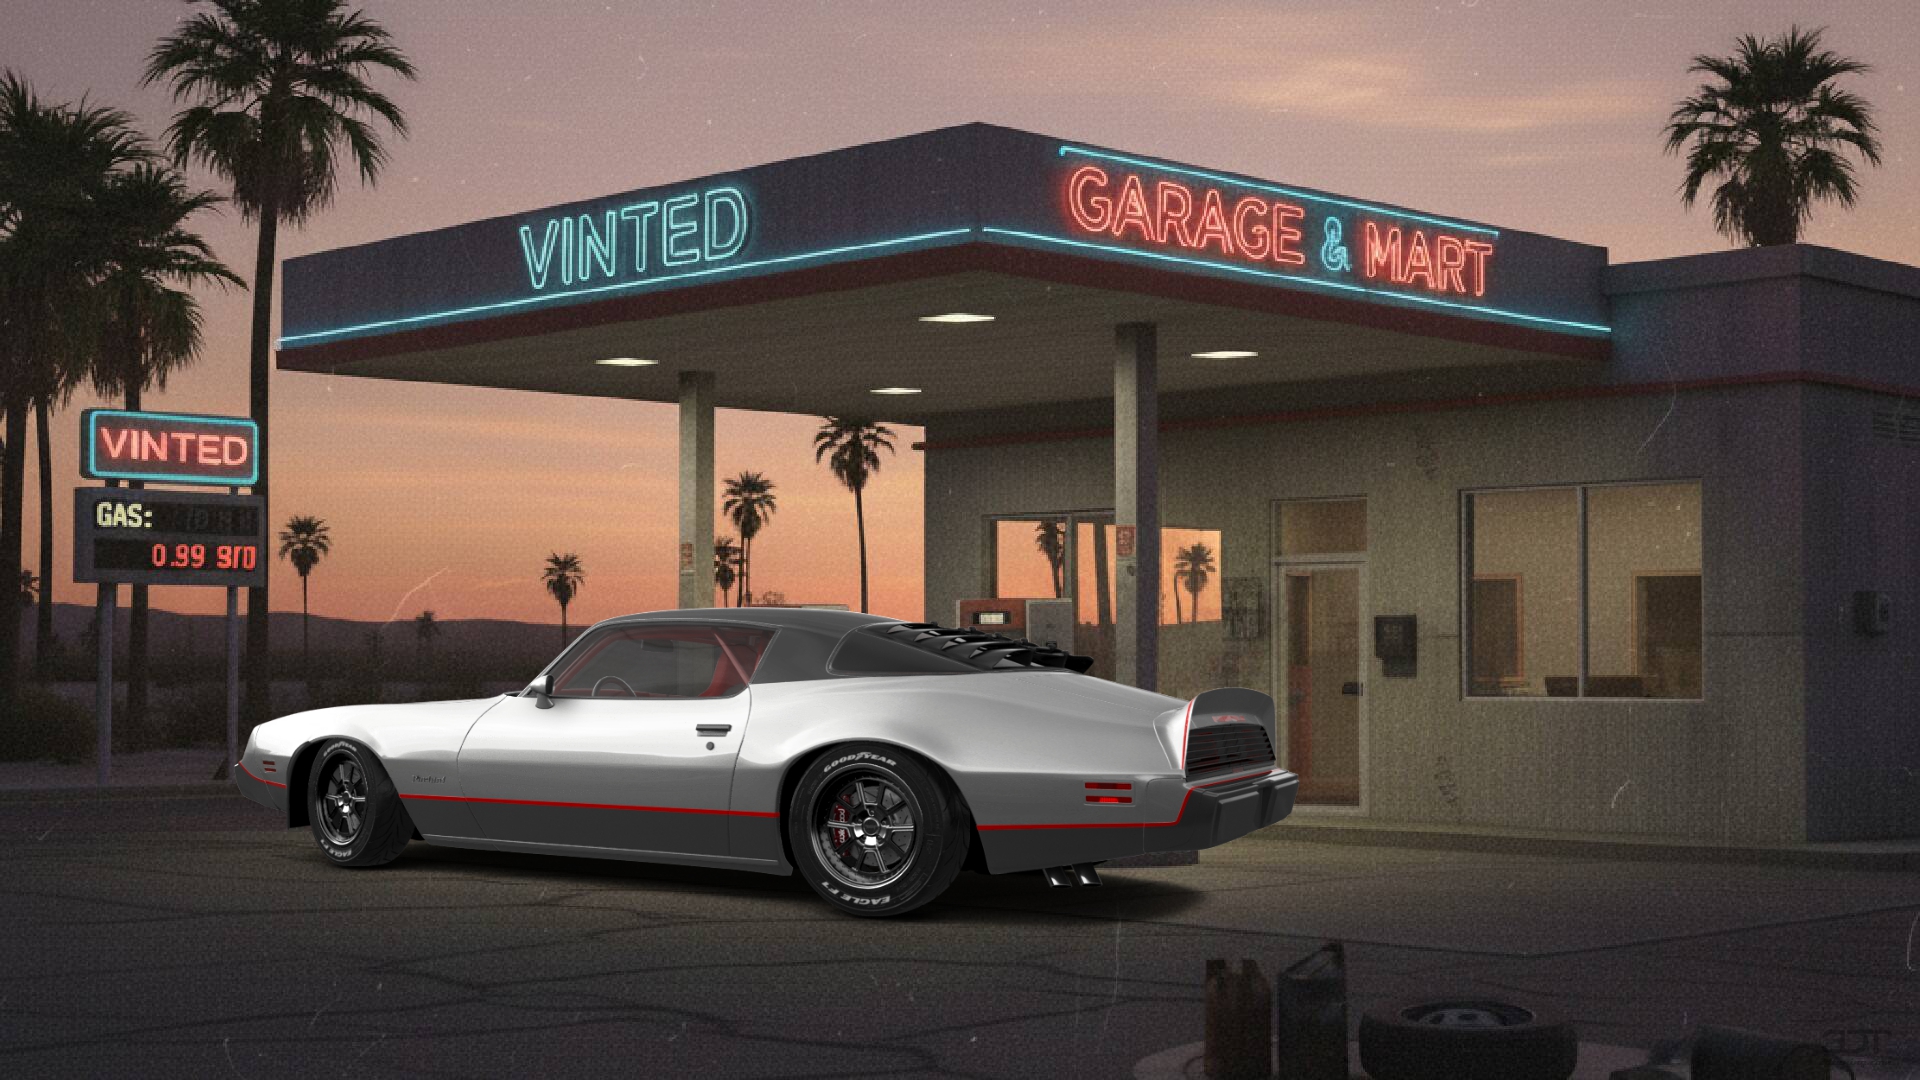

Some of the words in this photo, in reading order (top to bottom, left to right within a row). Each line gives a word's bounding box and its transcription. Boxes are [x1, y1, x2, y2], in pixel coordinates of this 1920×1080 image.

[518, 186, 748, 290] VINTED
[1067, 166, 1305, 265] GARAGE
[1320, 216, 1351, 272] &
[1364, 221, 1493, 297] MART
[101, 429, 248, 465] VINTED
[96, 502, 153, 528] GAS:
[151, 543, 206, 568] 0.99
[823, 751, 897, 773] GOODYEAR
[821, 881, 840, 895] F1
[840, 893, 891, 905] EAGLE
